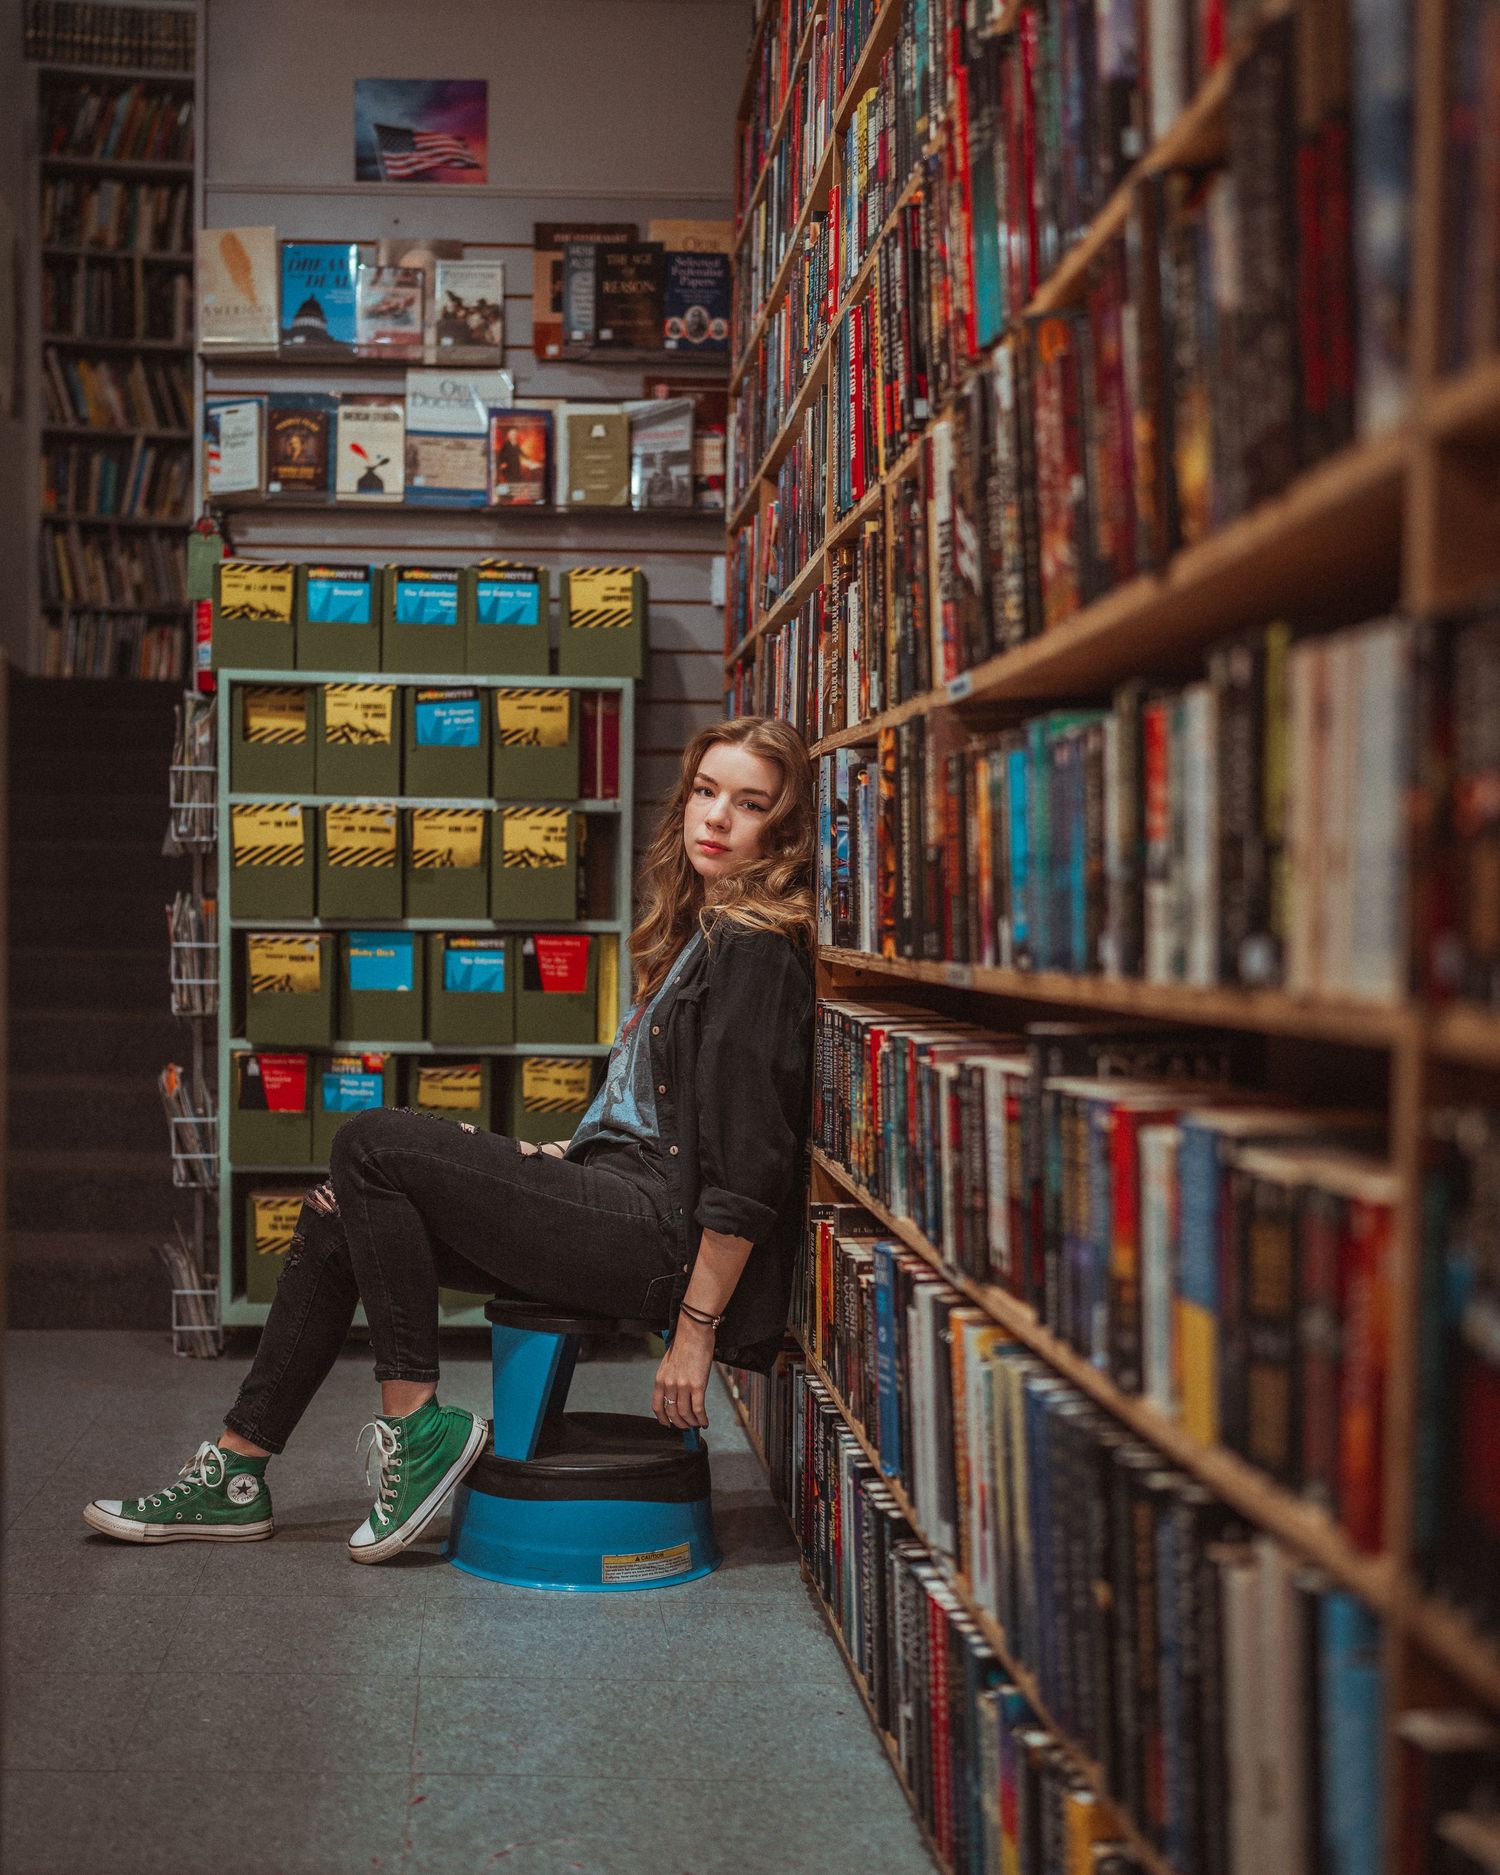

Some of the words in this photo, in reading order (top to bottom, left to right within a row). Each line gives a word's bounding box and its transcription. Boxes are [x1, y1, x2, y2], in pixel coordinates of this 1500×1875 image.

[602, 280, 656, 294] REASON
[404, 589, 417, 598] The
[434, 709, 447, 718] The
[448, 708, 474, 717] Grapes
[453, 716, 475, 725] Wrath
[460, 956, 473, 966] The
[340, 1078, 358, 1088] Pride
[361, 1079, 375, 1088] and
[340, 1087, 375, 1097] Prejudice
[640, 1552, 664, 1560] CAUTION
